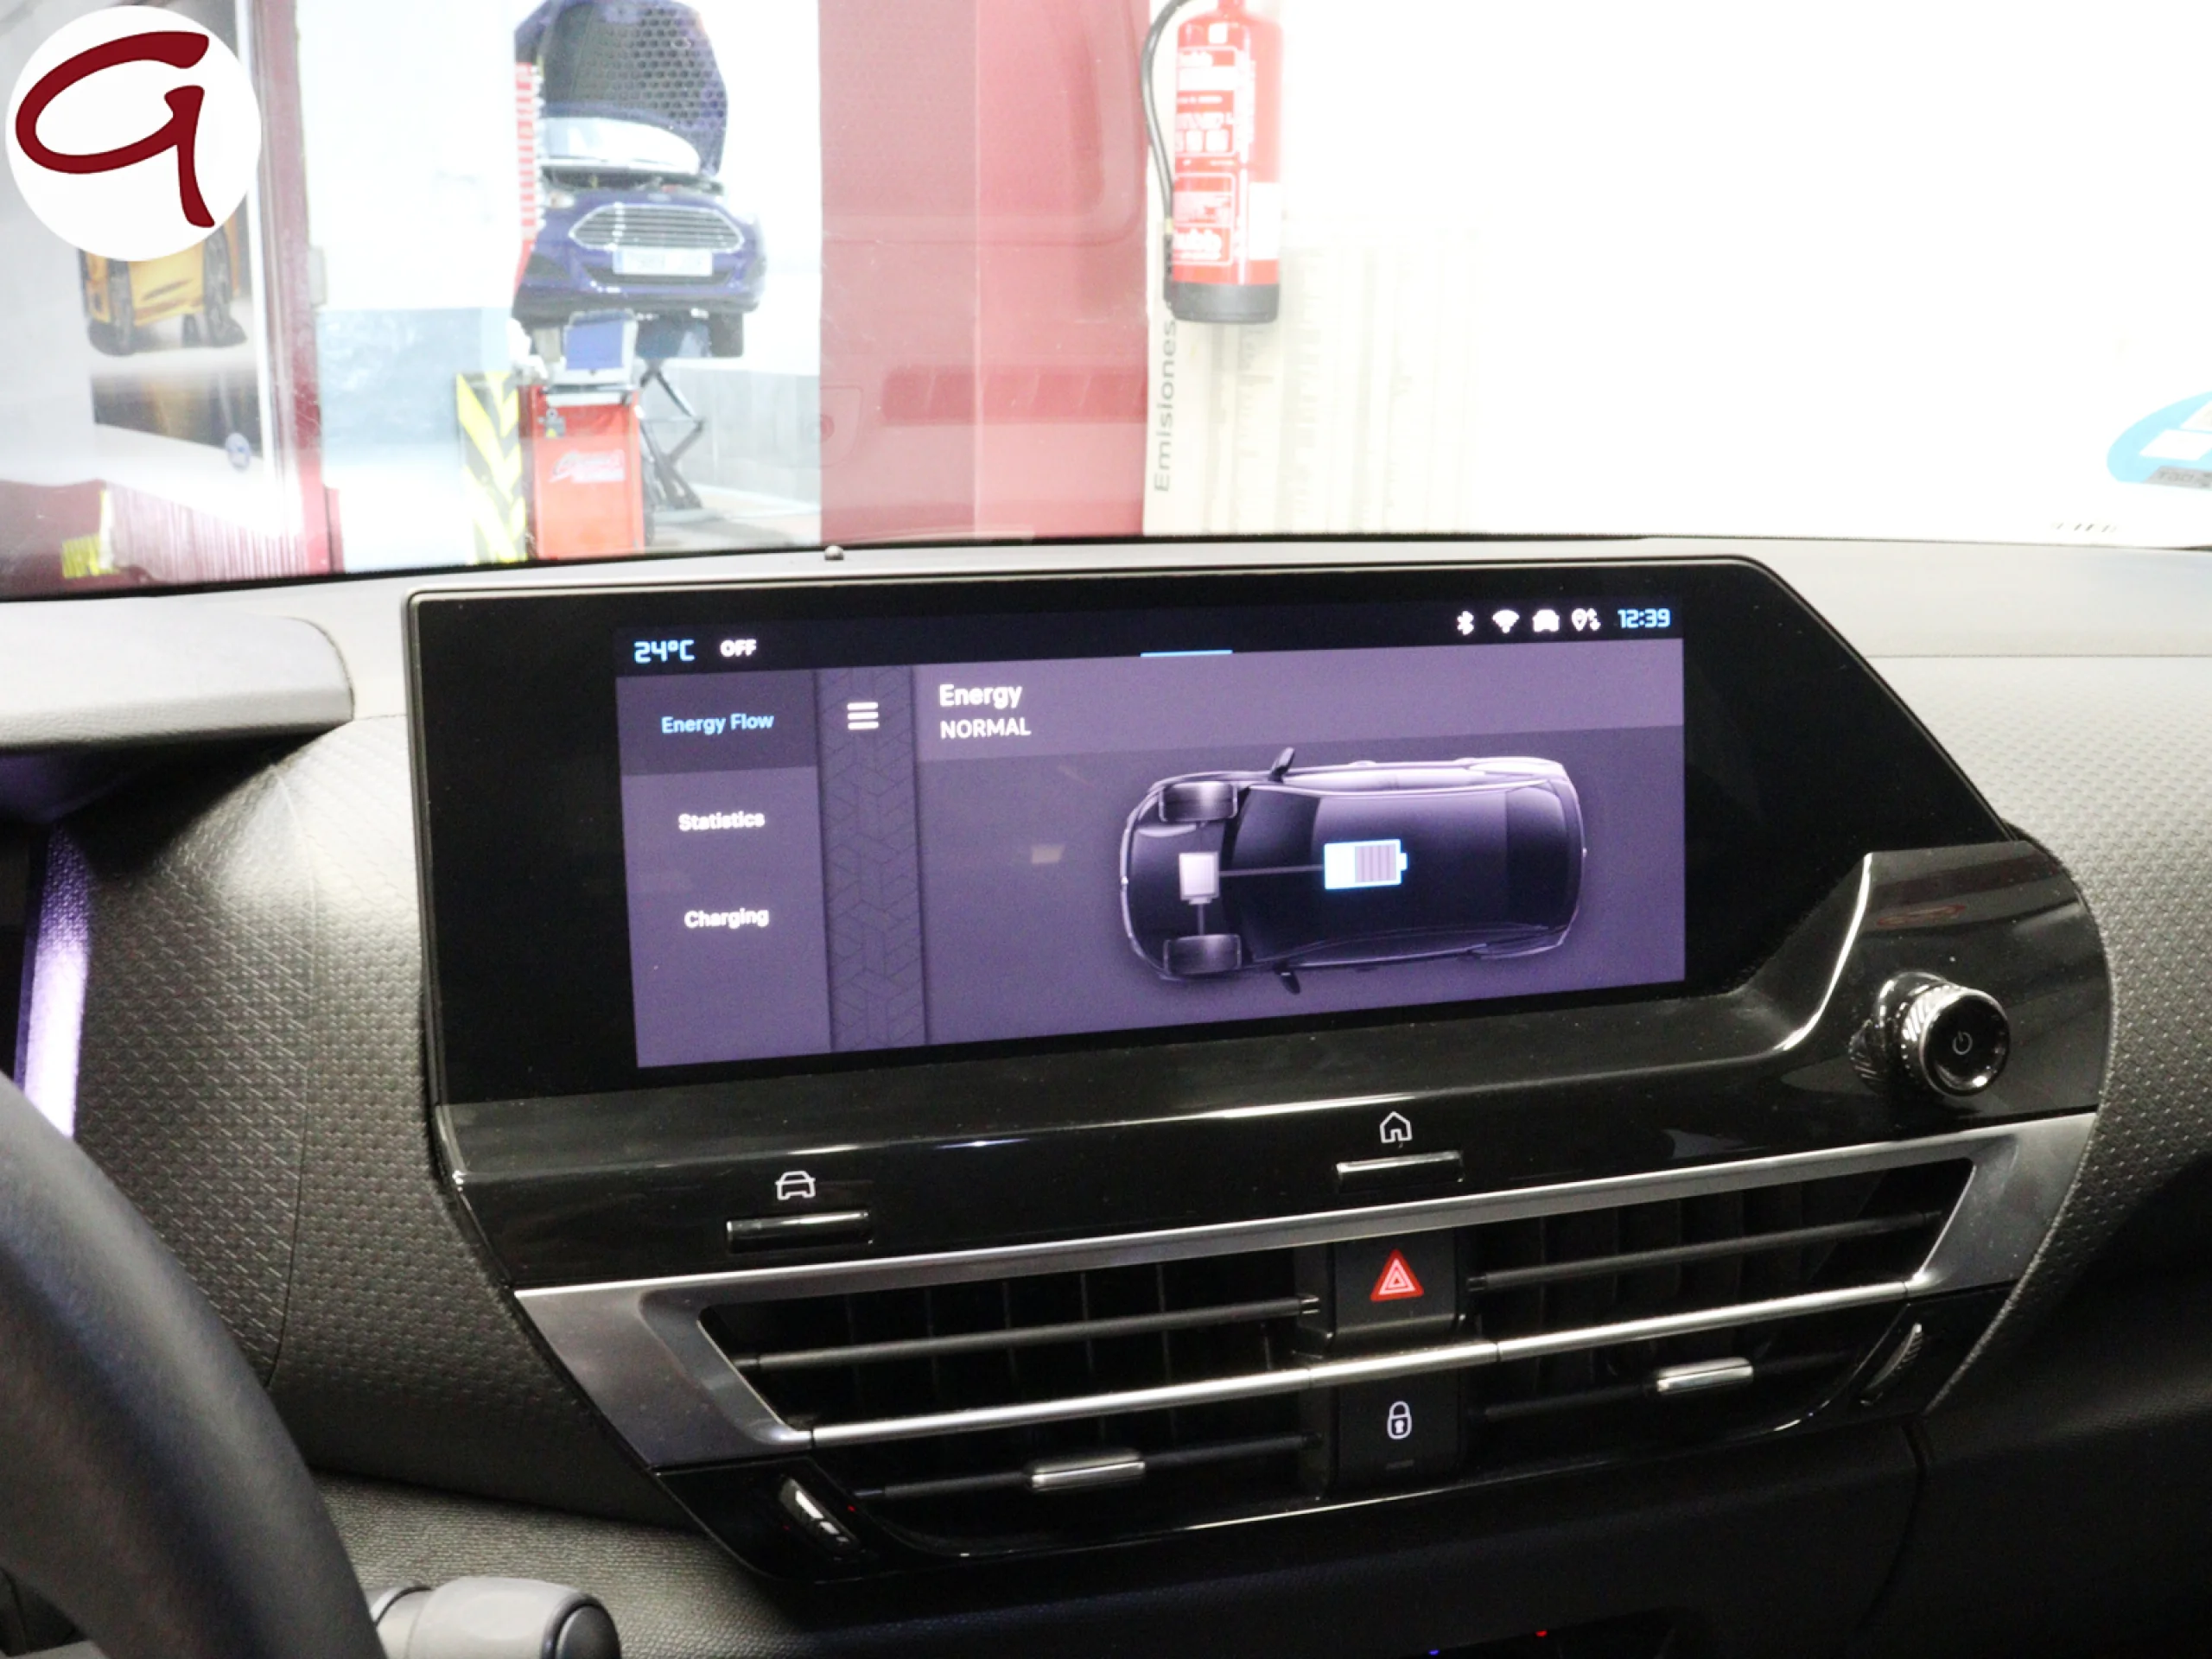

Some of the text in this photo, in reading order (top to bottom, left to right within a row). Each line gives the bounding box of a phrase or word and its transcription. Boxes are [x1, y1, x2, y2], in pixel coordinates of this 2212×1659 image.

[1154, 320, 1178, 492] Emisiones
[1618, 608, 1671, 628] 12:39
[719, 638, 757, 658] OFF
[938, 683, 1023, 710] Energy
[661, 712, 775, 734] Energy Flow
[939, 717, 1032, 740] NORMAL
[677, 810, 766, 831] Statistics
[683, 907, 769, 929] Charging
